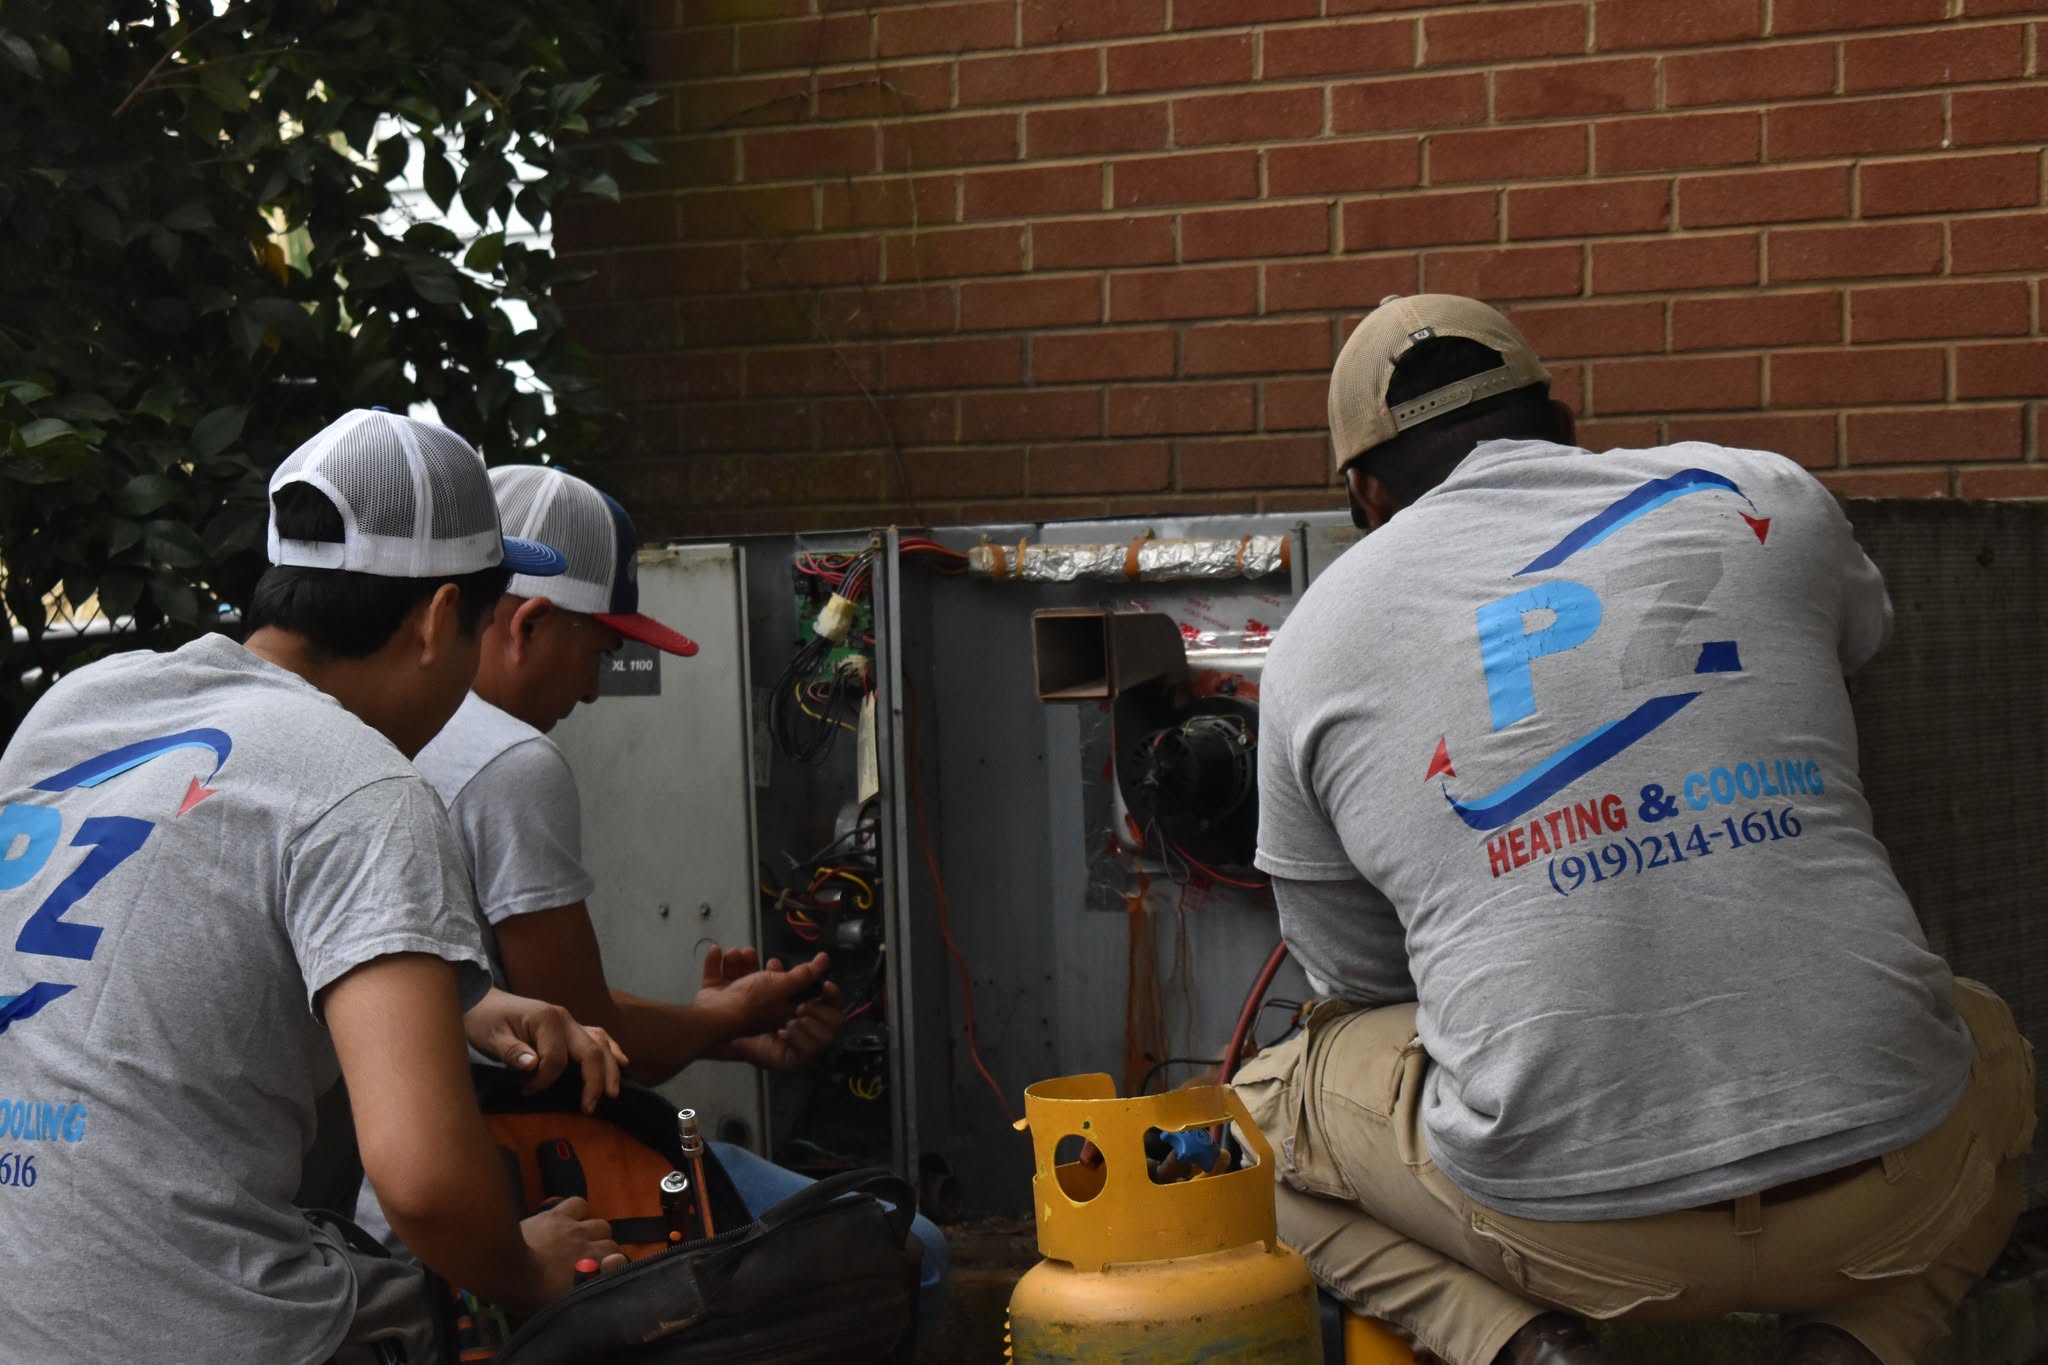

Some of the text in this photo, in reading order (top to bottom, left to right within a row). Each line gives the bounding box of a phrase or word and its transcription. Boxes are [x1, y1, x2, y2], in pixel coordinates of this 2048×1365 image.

[611, 659, 654, 672] XL 1100
[1486, 759, 1825, 878] HEATING & COOLING
[1548, 807, 1803, 896] (919)214-1616
